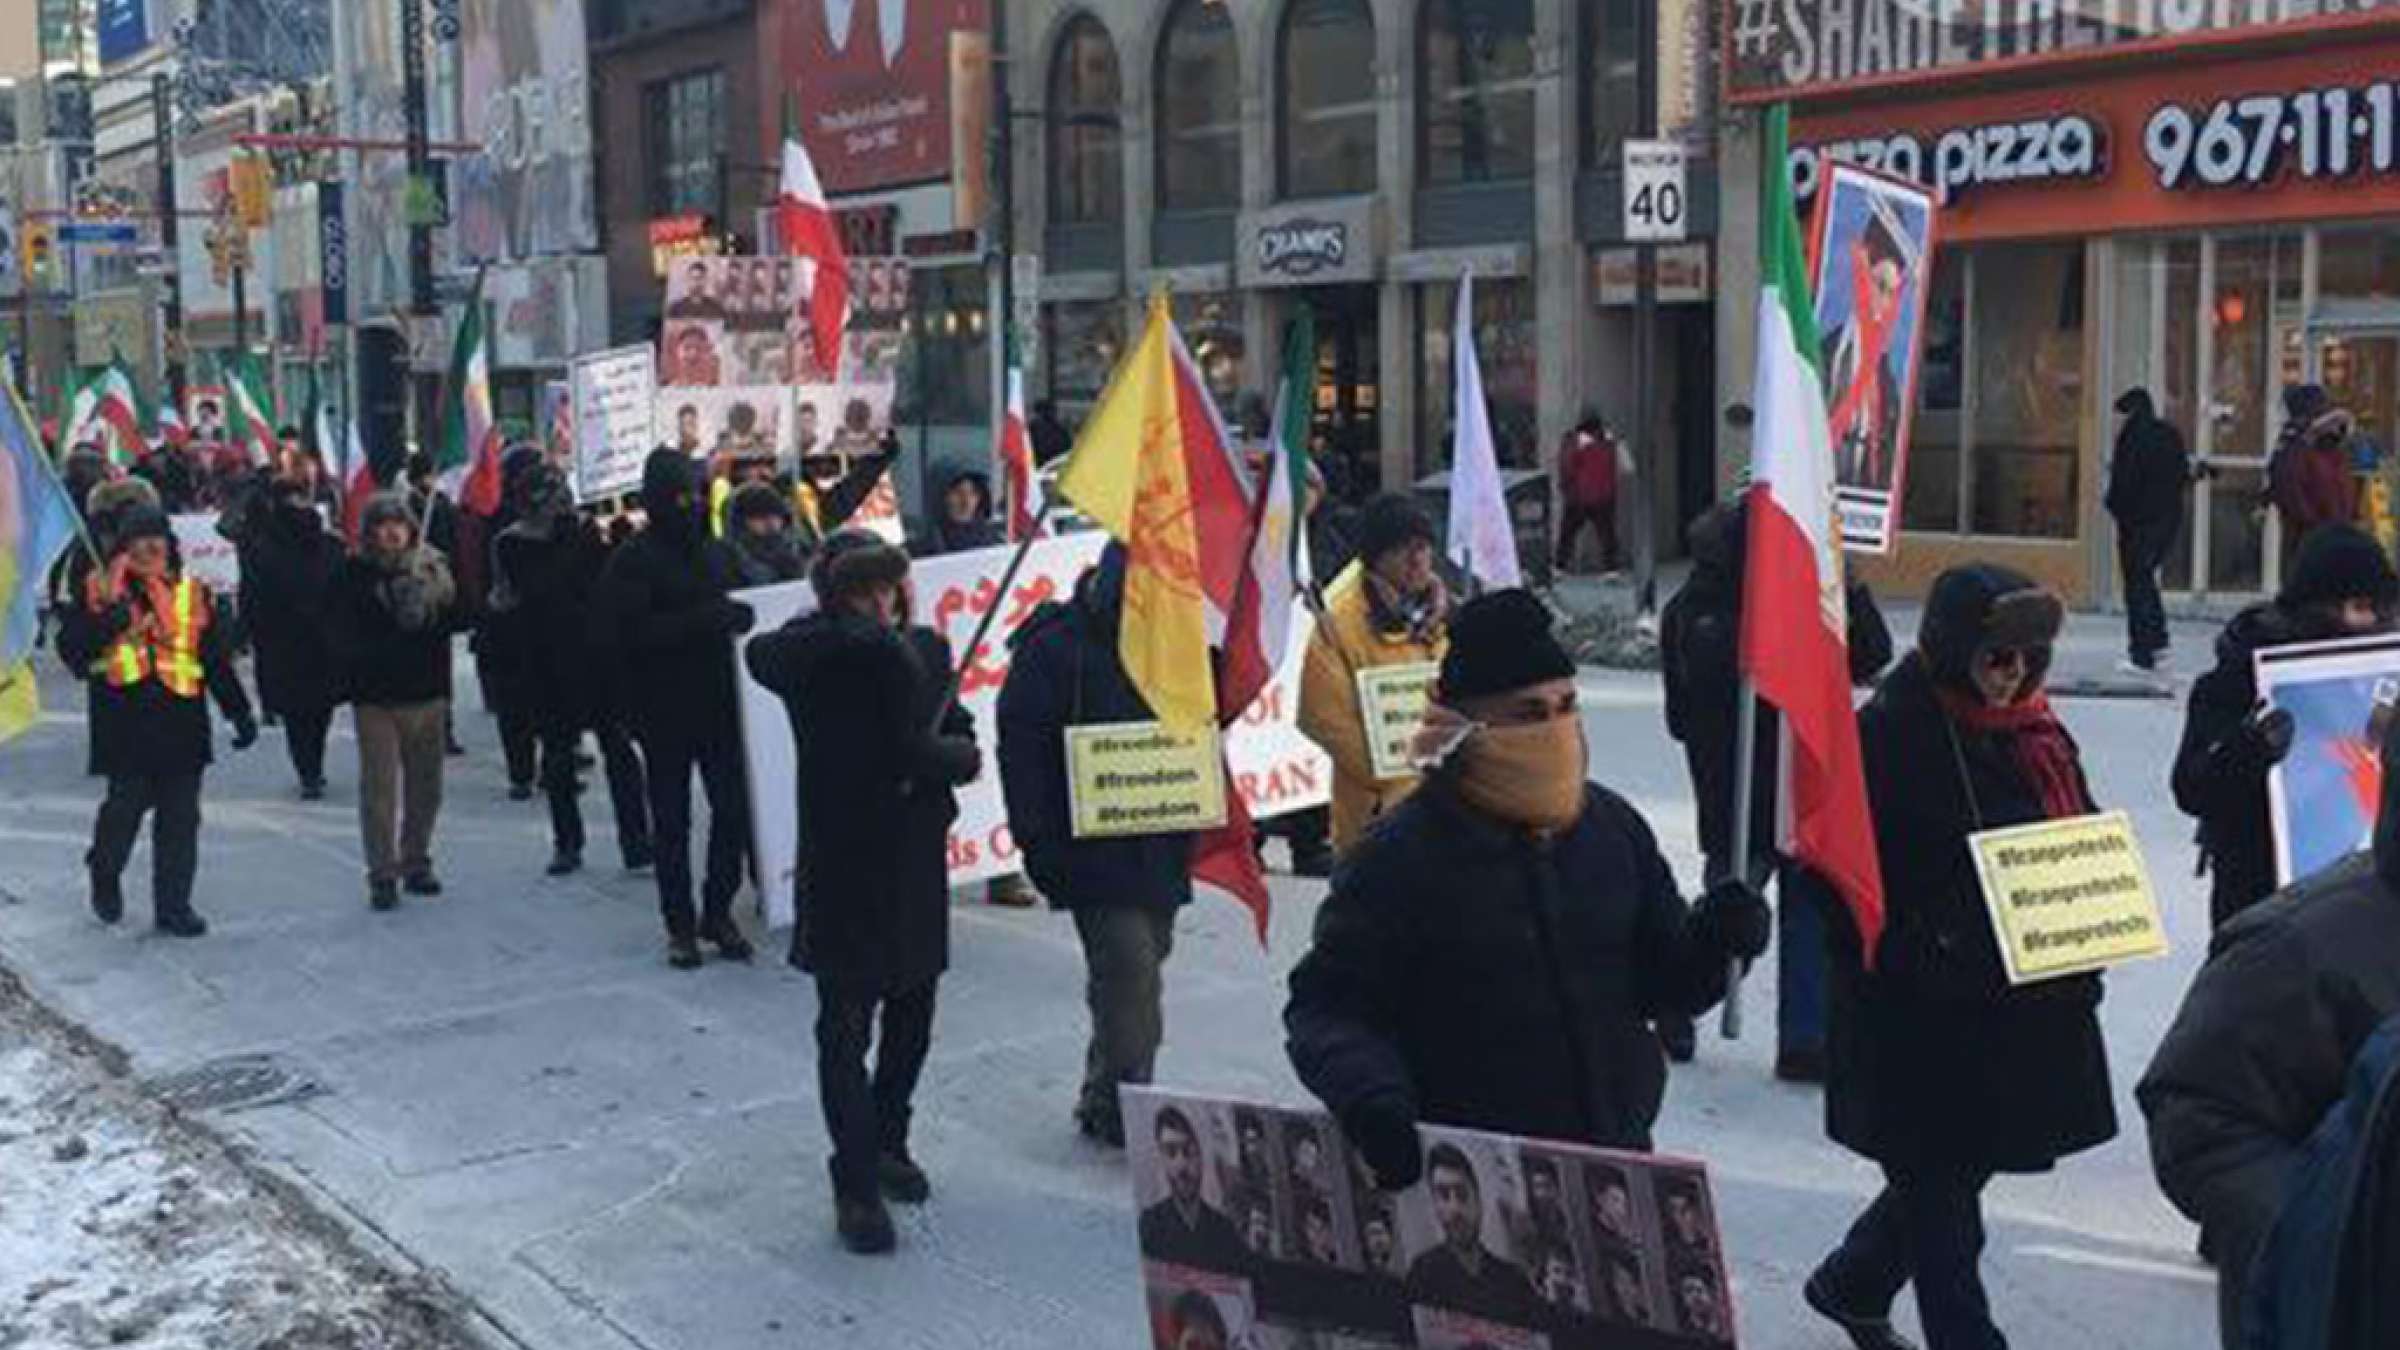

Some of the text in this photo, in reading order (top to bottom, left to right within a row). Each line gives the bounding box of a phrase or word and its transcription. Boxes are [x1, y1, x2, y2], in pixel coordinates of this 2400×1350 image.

[1935, 115, 2093, 207] pizza
[1630, 181, 1681, 225] 40
[1095, 767, 1200, 790] #freedom
[1098, 801, 1201, 823] #freedom
